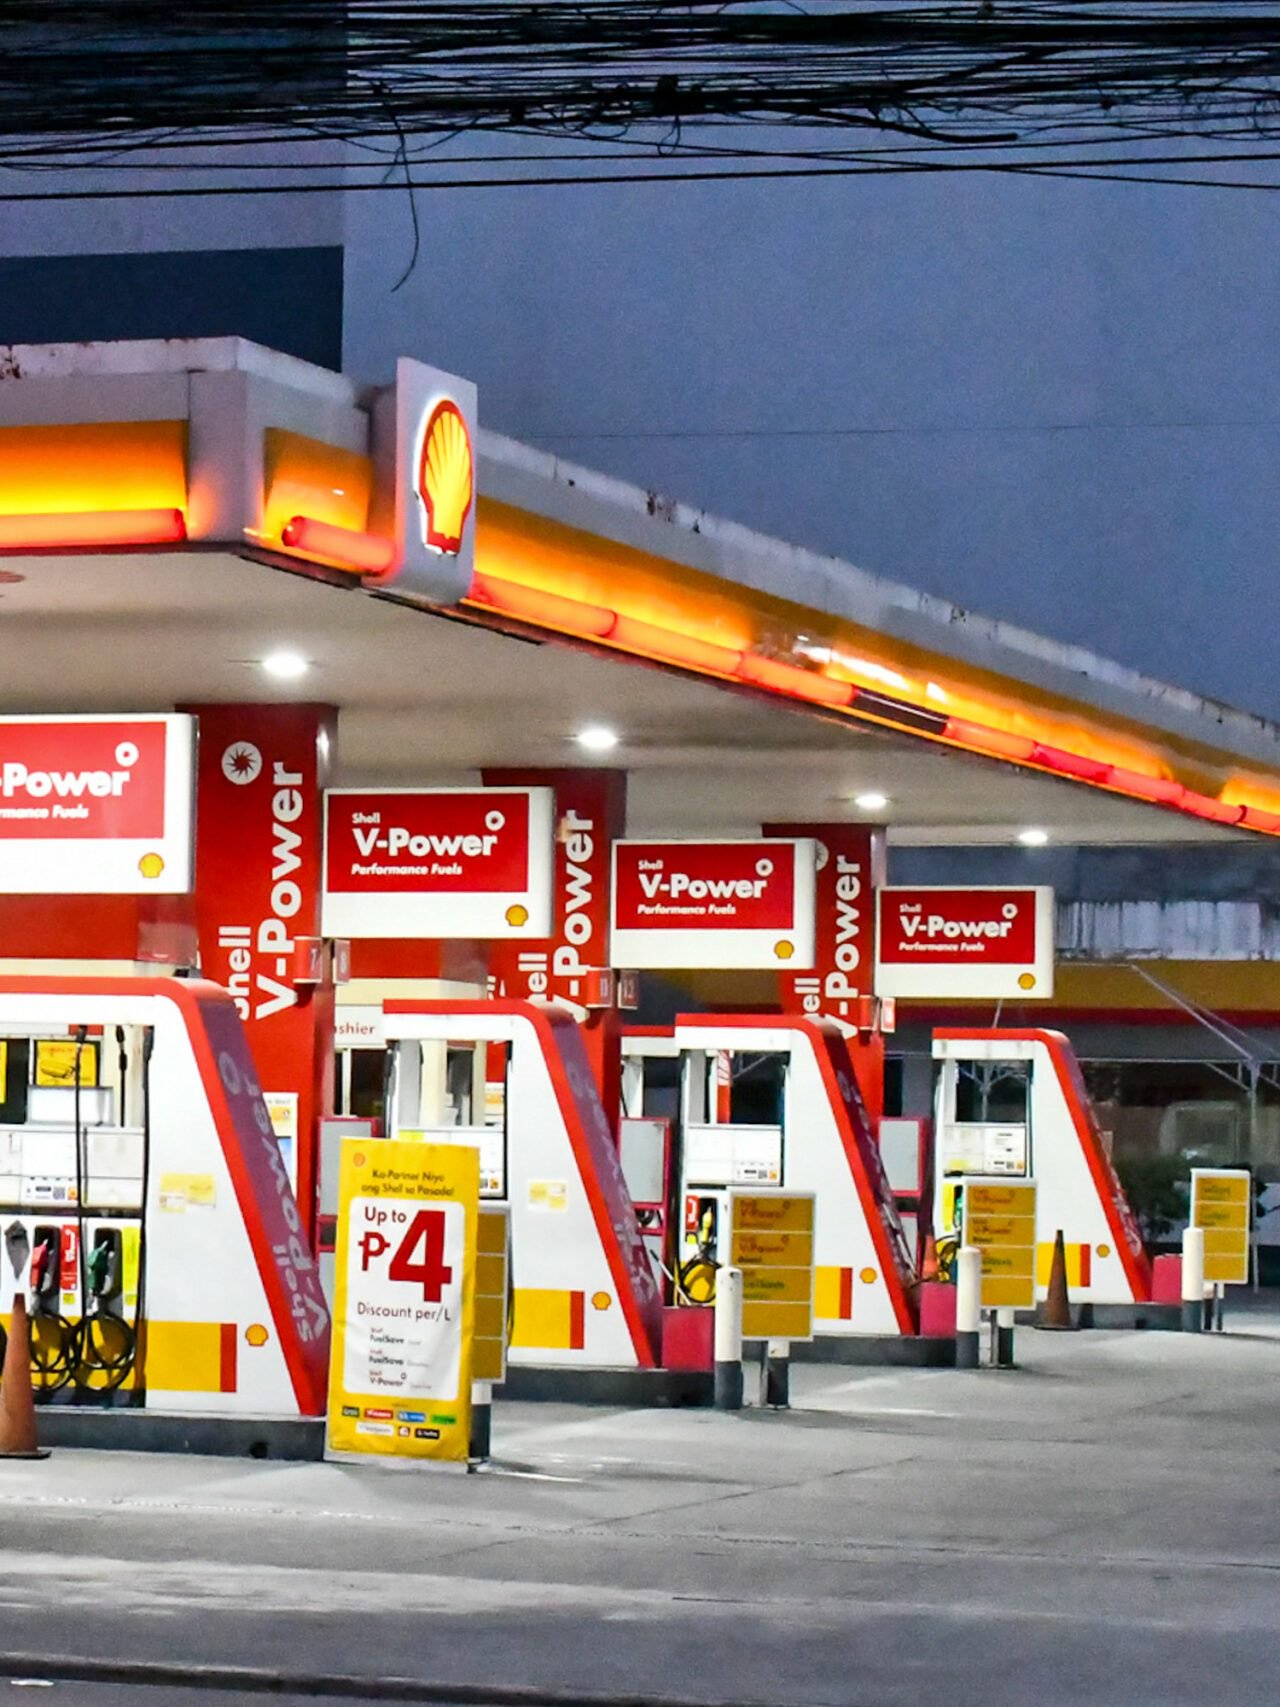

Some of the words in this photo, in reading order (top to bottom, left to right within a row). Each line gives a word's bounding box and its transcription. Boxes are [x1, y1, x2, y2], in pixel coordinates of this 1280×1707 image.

[52, 803, 89, 818] Fuels
[352, 812, 381, 824] Shell
[352, 827, 498, 857] V-Power
[351, 862, 428, 875] Performance
[431, 862, 463, 875] Fuels
[638, 859, 664, 870] Shell
[255, 761, 303, 1020] V-Power
[638, 873, 767, 899] V-Power
[637, 904, 706, 915] Performance
[708, 904, 736, 915] Fuels
[899, 903, 922, 913] Shell
[899, 915, 1012, 938] V-Power
[898, 941, 959, 952] Performance
[960, 941, 985, 952] Fuels
[364, 1206, 387, 1226] Up
[392, 1210, 407, 1223] to
[273, 1244, 314, 1343] Shell
[357, 1302, 412, 1319] Discount
